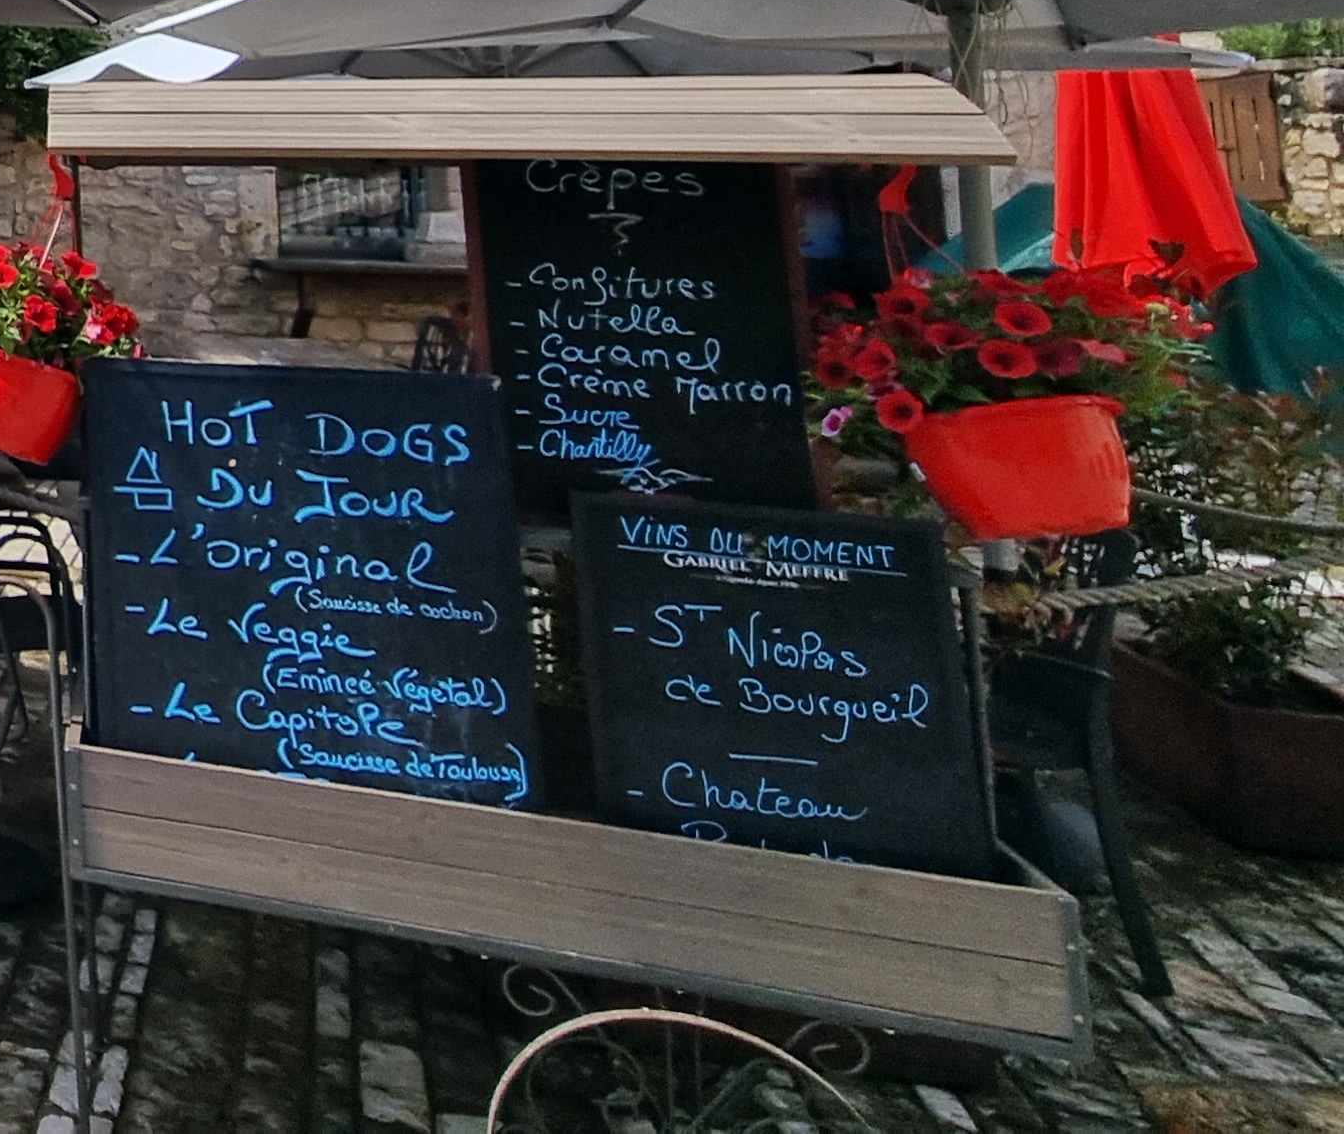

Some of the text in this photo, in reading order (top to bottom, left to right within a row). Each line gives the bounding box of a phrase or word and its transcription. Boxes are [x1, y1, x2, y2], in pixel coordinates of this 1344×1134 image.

[528, 262, 717, 306] Confitures
[538, 298, 696, 336] Nutella
[540, 333, 721, 374] Caramel
[537, 362, 792, 415] Crème Marron
[539, 393, 640, 430] Sucre
[305, 412, 472, 466] DOGS
[539, 427, 658, 478] Chantilly
[662, 549, 752, 574] GABRIEL
[709, 526, 744, 554] DU
[766, 534, 895, 568] MOMENT
[147, 597, 377, 664] Le Veggie
[386, 596, 414, 616] de
[727, 611, 869, 677] Nicolas
[164, 681, 424, 750] Le Capitole
[665, 674, 929, 743] de Bourgueil
[661, 761, 869, 821] Chateau
